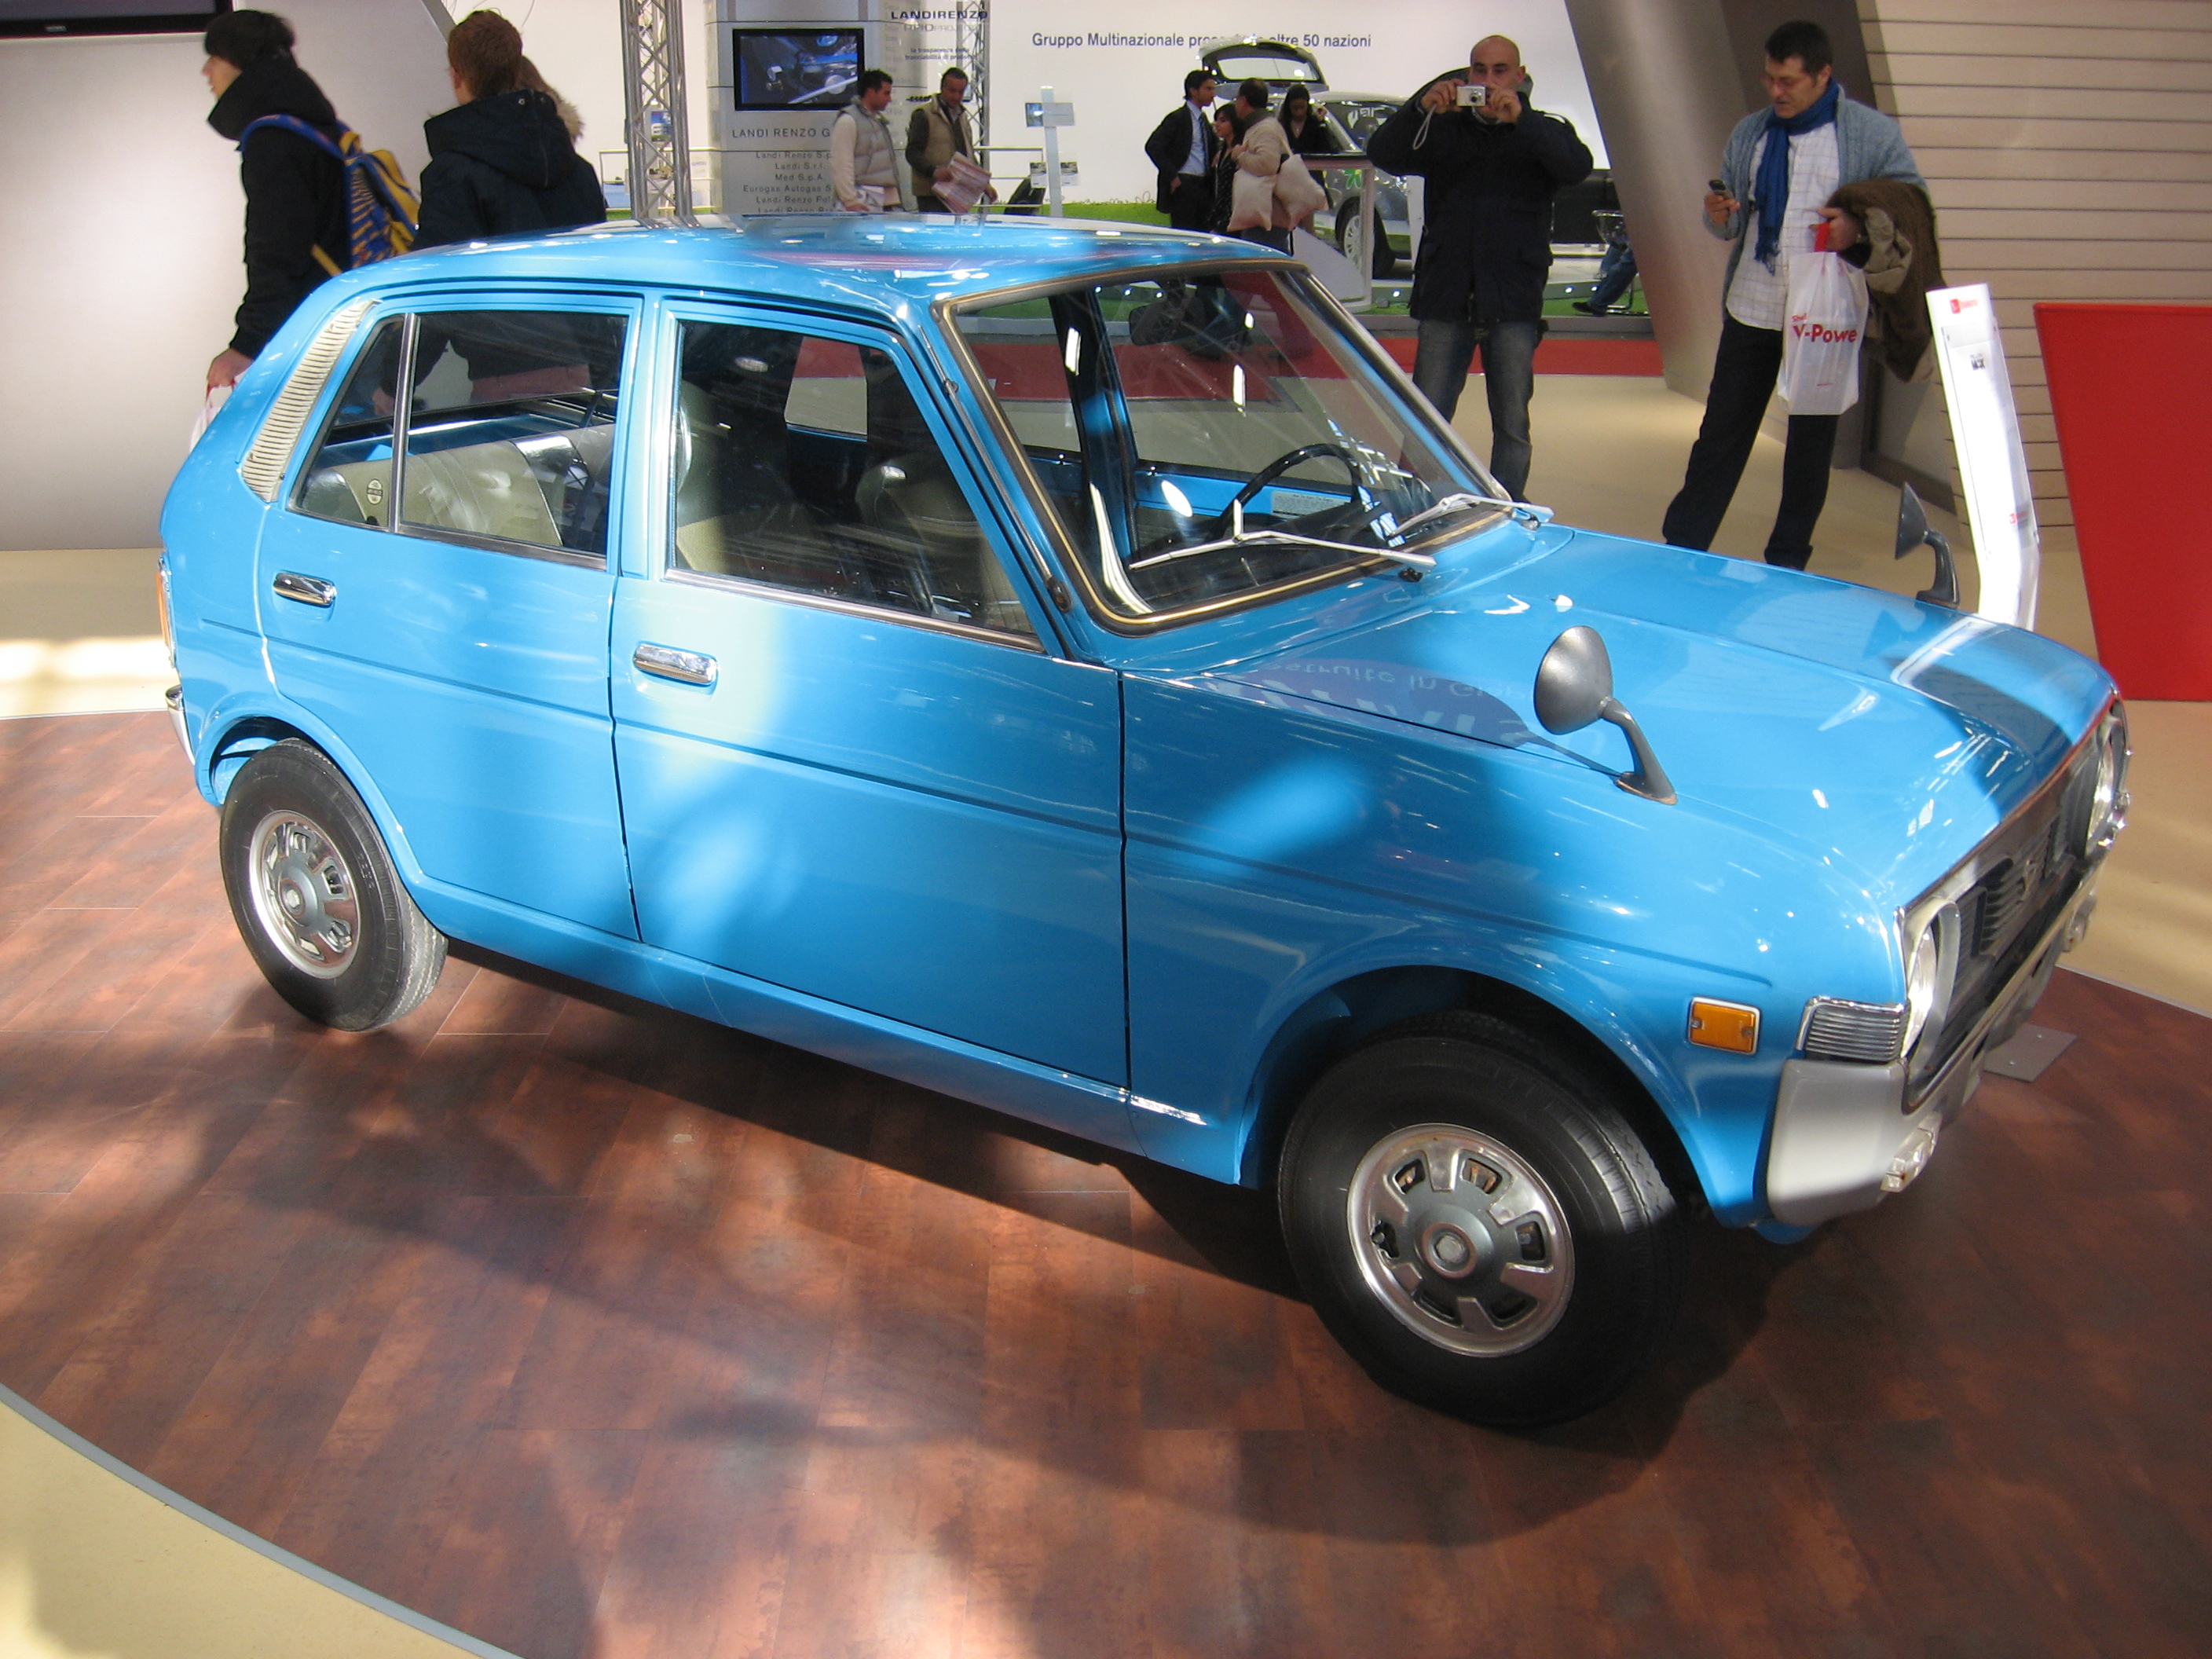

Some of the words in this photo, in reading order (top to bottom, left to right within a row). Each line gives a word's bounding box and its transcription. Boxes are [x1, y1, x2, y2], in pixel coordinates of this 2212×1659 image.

[891, 10, 988, 20] LANDIRENZO
[1031, 32, 1083, 48] Gruppo
[1087, 32, 1185, 46] Multinazionale
[1302, 34, 1320, 47] 50
[1324, 34, 1372, 47] nazioni
[732, 128, 768, 138] LANDI
[774, 128, 817, 137] RENZO
[743, 185, 781, 194] Eurogas
[784, 185, 822, 194] Autogas
[1793, 323, 1858, 343] V-Powe
